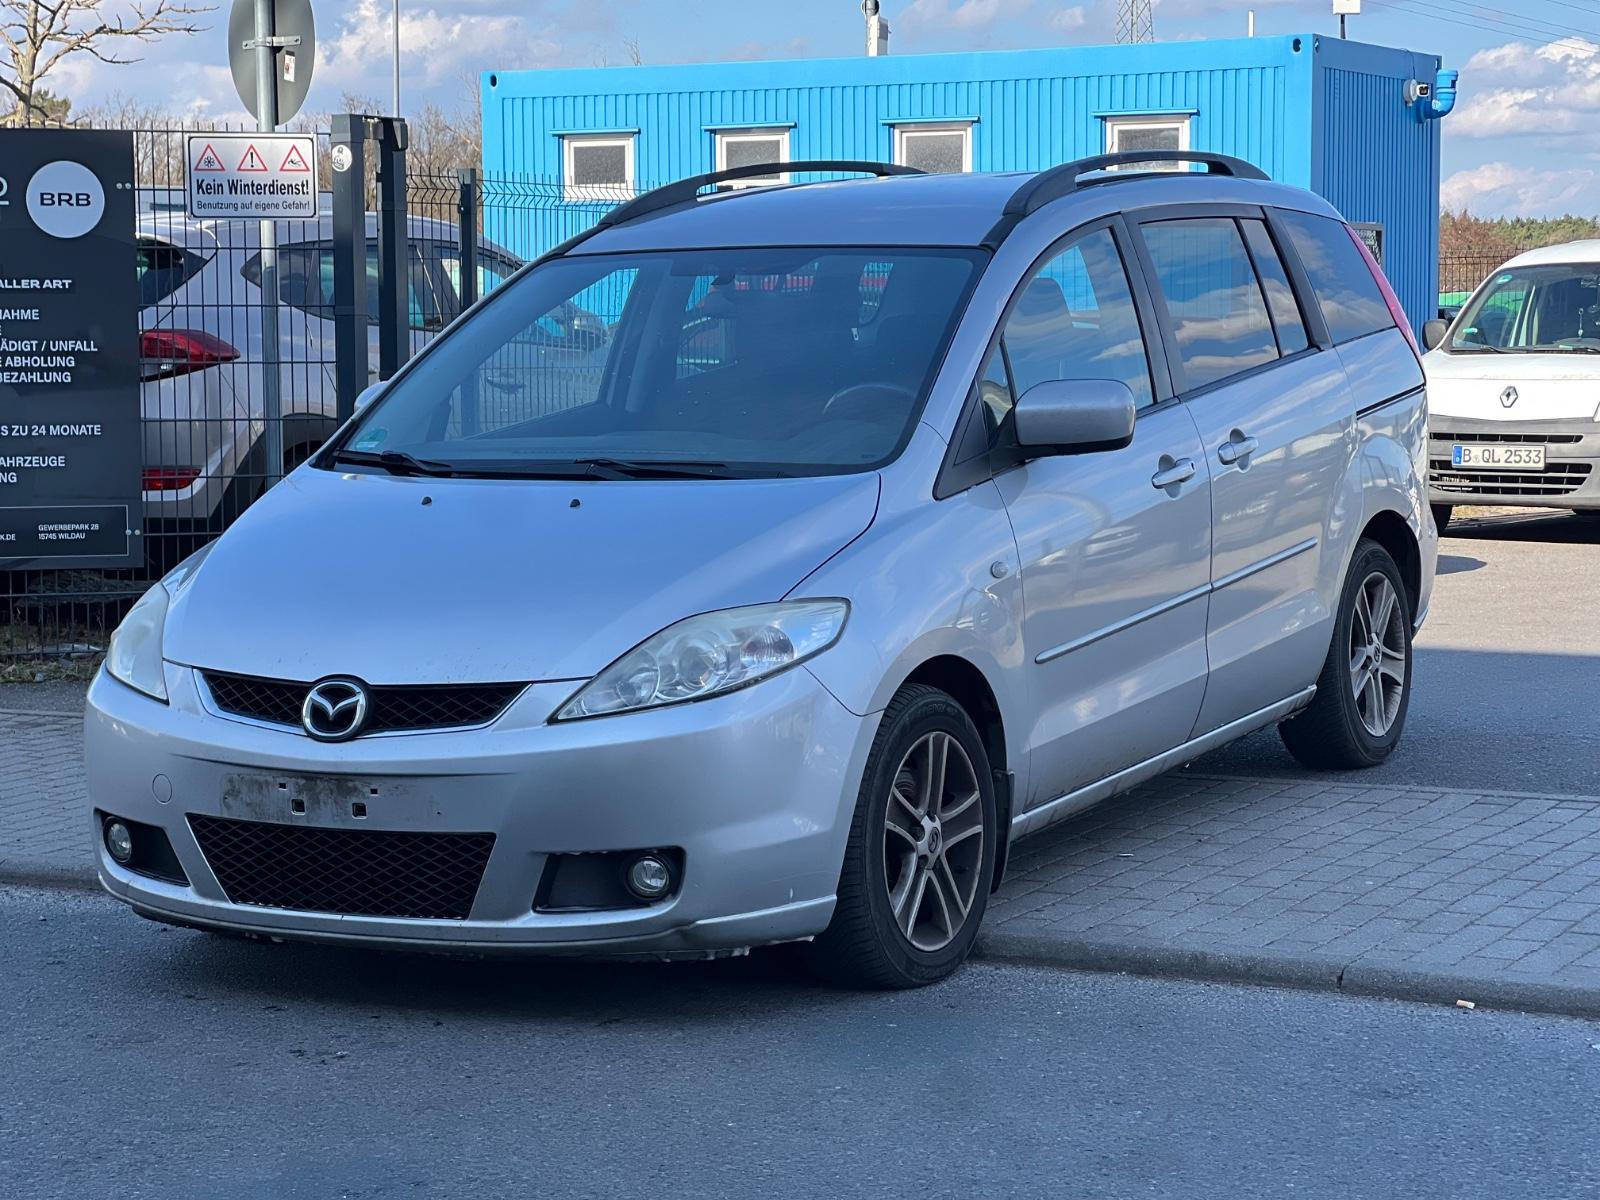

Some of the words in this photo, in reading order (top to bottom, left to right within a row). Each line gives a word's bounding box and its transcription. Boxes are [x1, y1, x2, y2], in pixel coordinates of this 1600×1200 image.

[196, 179, 224, 195] Kein
[227, 179, 309, 195] Winterdienst!
[39, 192, 91, 207] BRB
[197, 200, 239, 211] Benutzung
[240, 200, 252, 210] auf
[254, 200, 280, 211] eigene
[282, 200, 310, 210] Gefahr!
[42, 279, 72, 289] ART
[0, 309, 40, 320] AHME
[41, 340, 47, 352] /
[49, 340, 98, 352] UNFALL
[5, 356, 75, 367] ABHOLUNG
[0, 372, 71, 383] EZAHLUNG
[11, 425, 28, 436] ZU
[31, 425, 46, 436] 24
[49, 424, 102, 435] MONATE
[1463, 449, 1472, 463] B
[1482, 449, 1501, 464] QL
[1504, 449, 1541, 464] 2533
[58, 532, 86, 540] WILDAU
